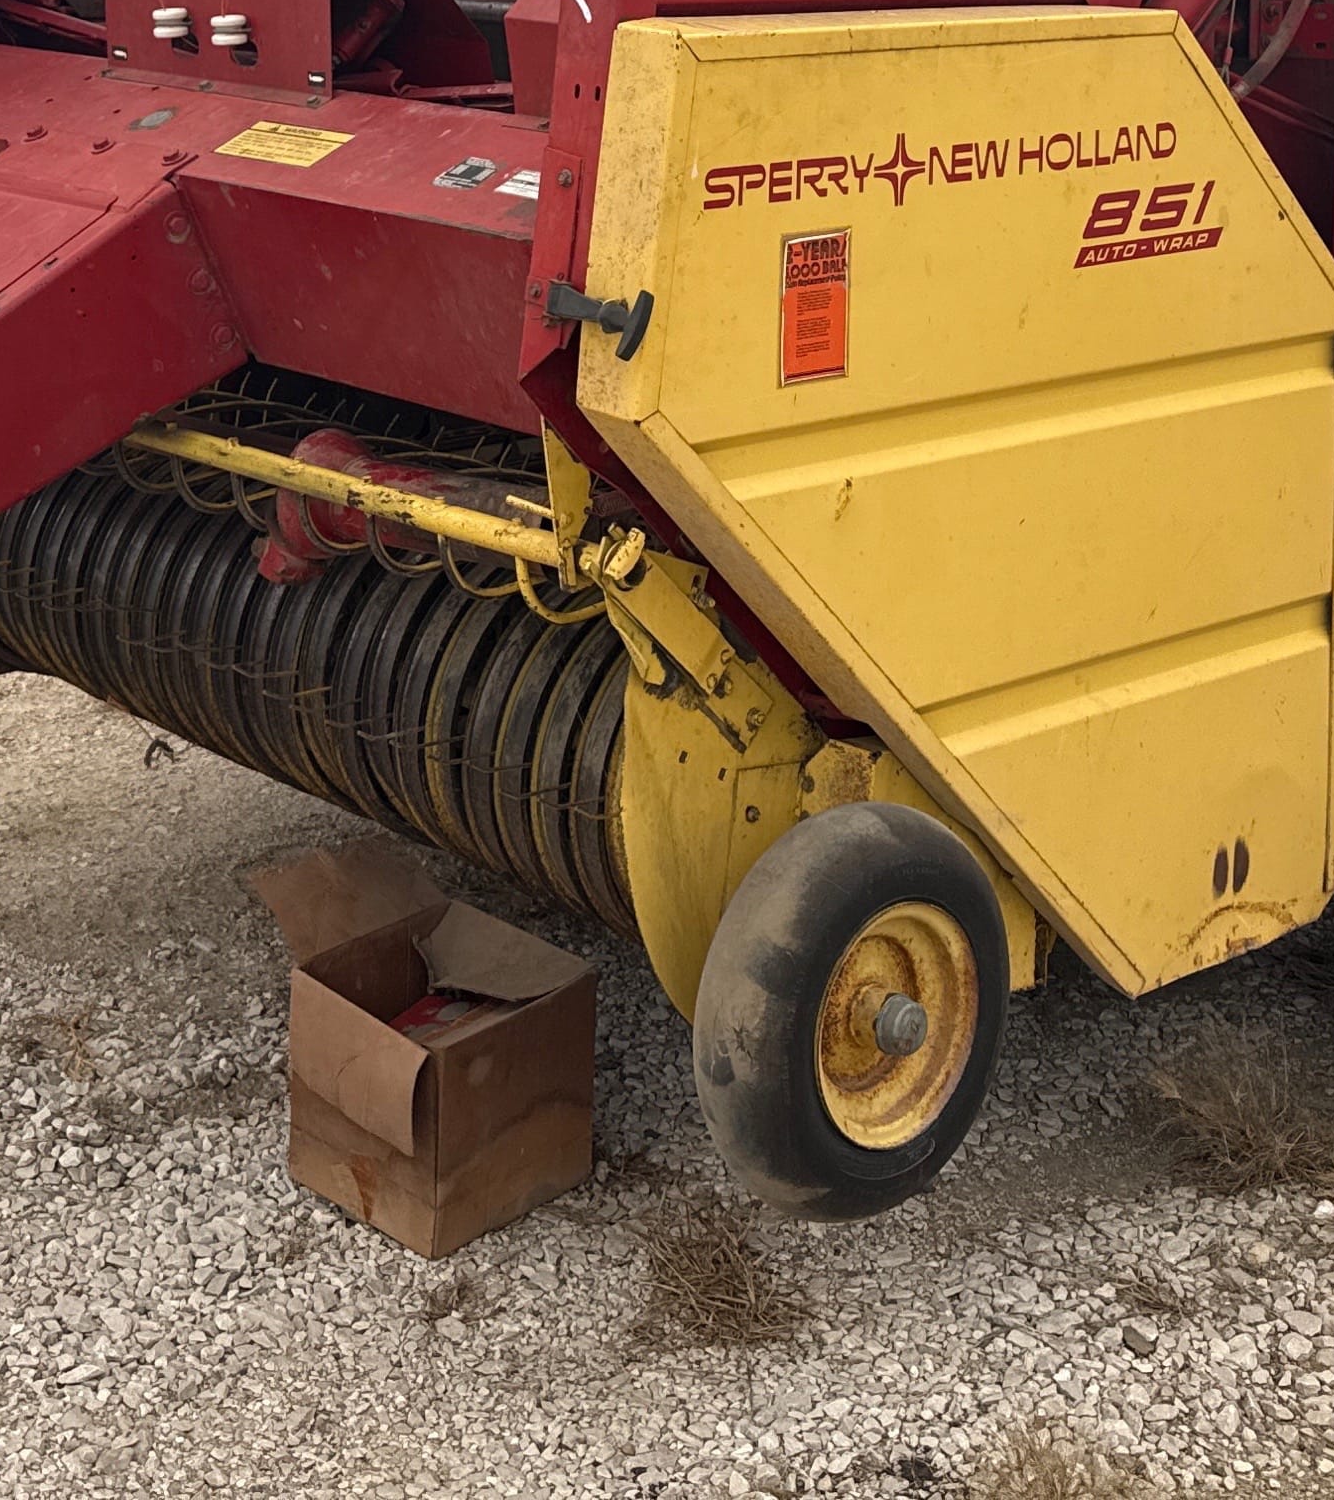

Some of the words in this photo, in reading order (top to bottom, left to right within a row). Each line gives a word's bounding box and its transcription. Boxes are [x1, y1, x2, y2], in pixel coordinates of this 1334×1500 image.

[703, 153, 875, 210] SPERRY
[928, 138, 1010, 185] NEW
[1019, 121, 1177, 176] HOLLAND
[1082, 180, 1216, 240] 851
